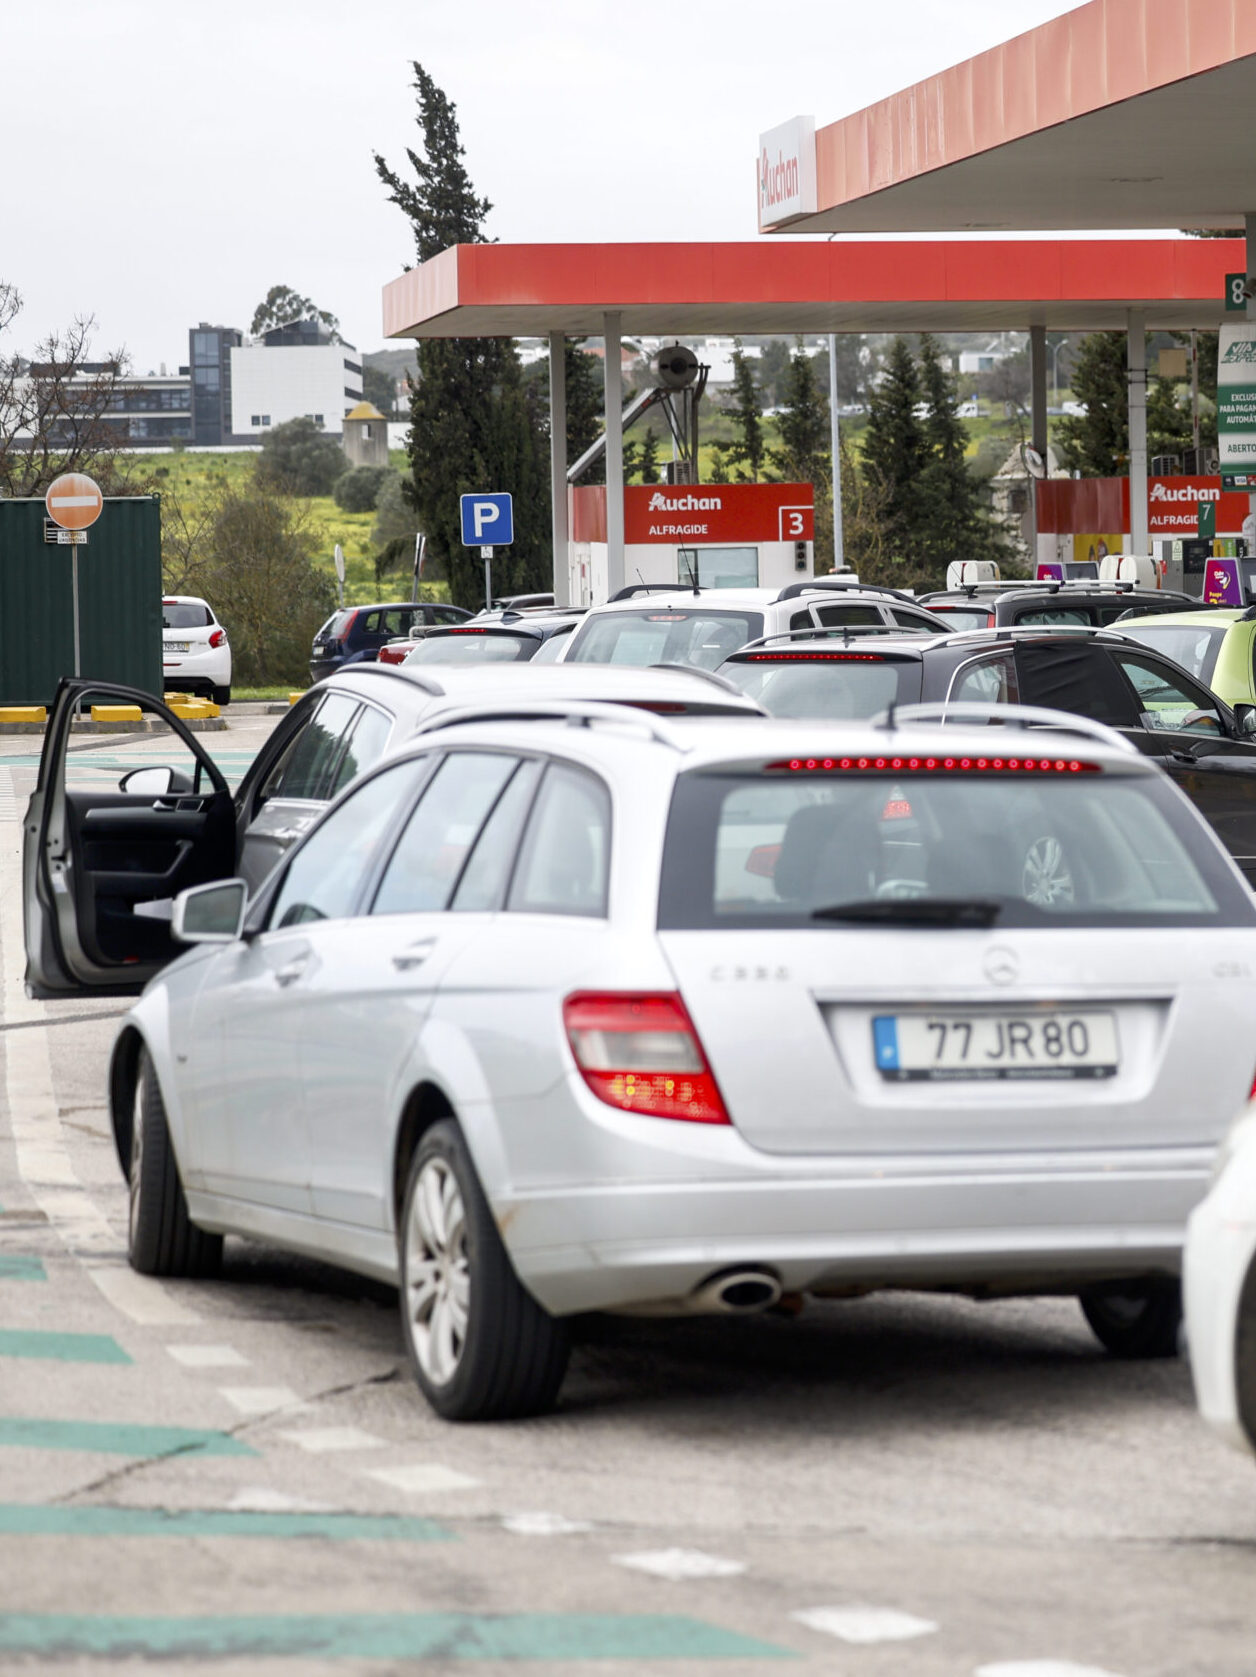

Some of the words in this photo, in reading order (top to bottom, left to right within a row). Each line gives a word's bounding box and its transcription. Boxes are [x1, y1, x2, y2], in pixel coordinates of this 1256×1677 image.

[760, 147, 799, 209] Auchan
[1231, 278, 1245, 304] 8
[1219, 404, 1236, 413] PARA
[648, 491, 722, 511] Auchan
[1150, 483, 1221, 502] Auchan
[473, 502, 500, 537] P
[1150, 514, 1198, 526] ALFRAGID
[1202, 504, 1211, 521] 7
[648, 523, 708, 536] ALFRAGIDE
[788, 512, 804, 536] 3
[927, 1021, 973, 1060] 77
[985, 1020, 1036, 1060] JR
[1042, 1019, 1090, 1058] 80
